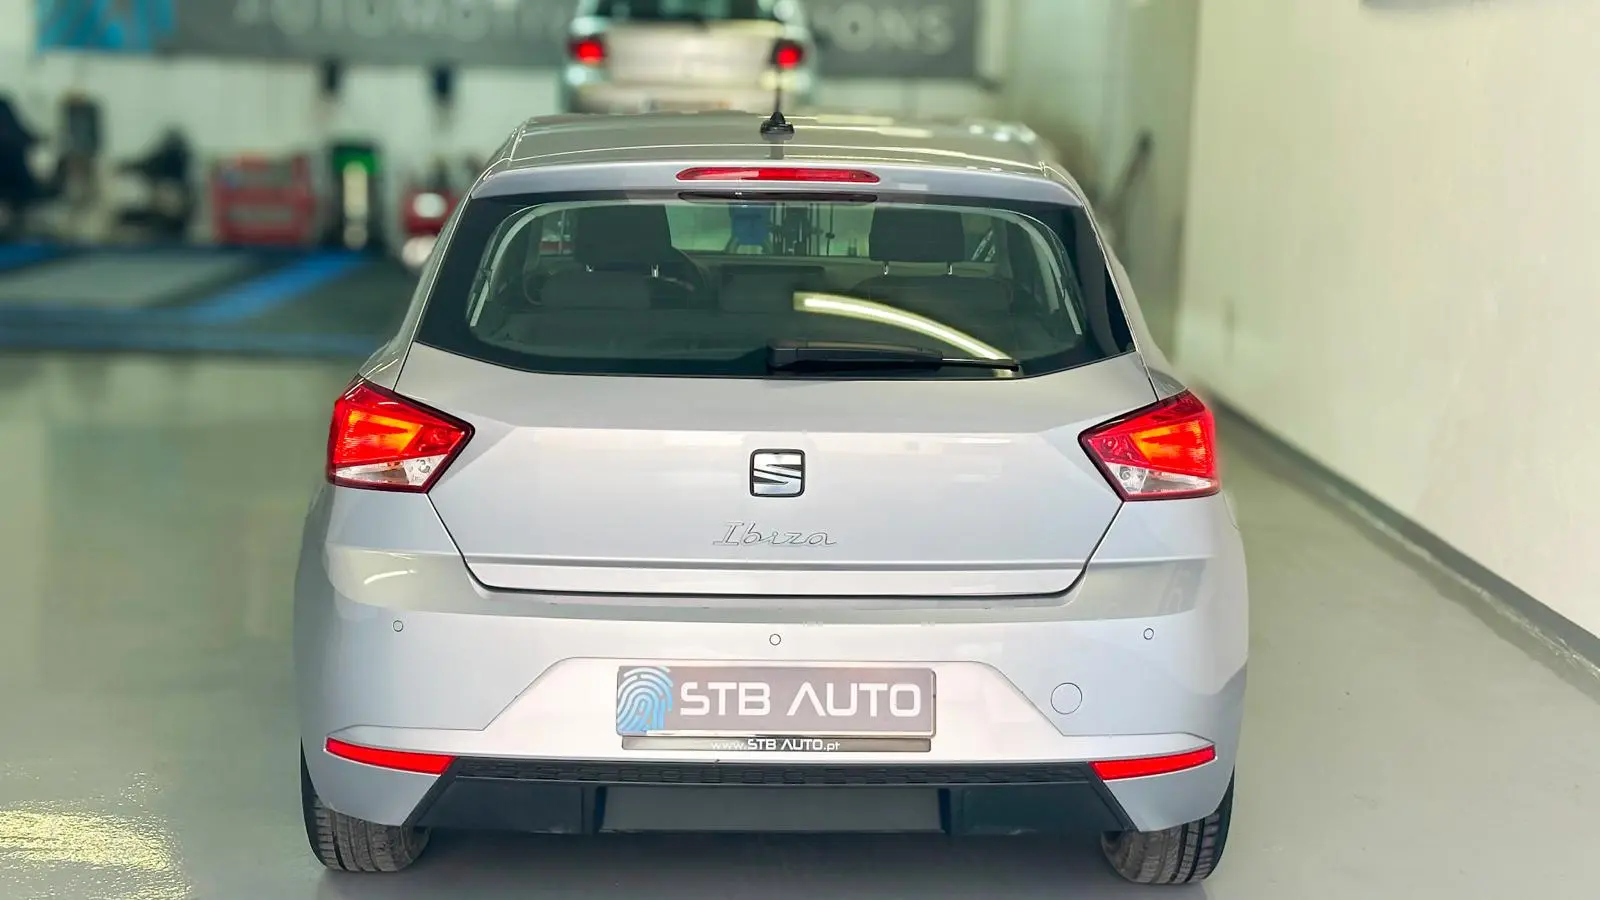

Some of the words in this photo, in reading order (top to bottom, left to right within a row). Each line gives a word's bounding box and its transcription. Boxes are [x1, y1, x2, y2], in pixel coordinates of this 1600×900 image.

[712, 521, 837, 546] Ibiza
[680, 682, 770, 716] STB
[787, 683, 921, 717] AUTO
[711, 738, 777, 751] www.STB
[780, 739, 840, 752] AUTO.pt
